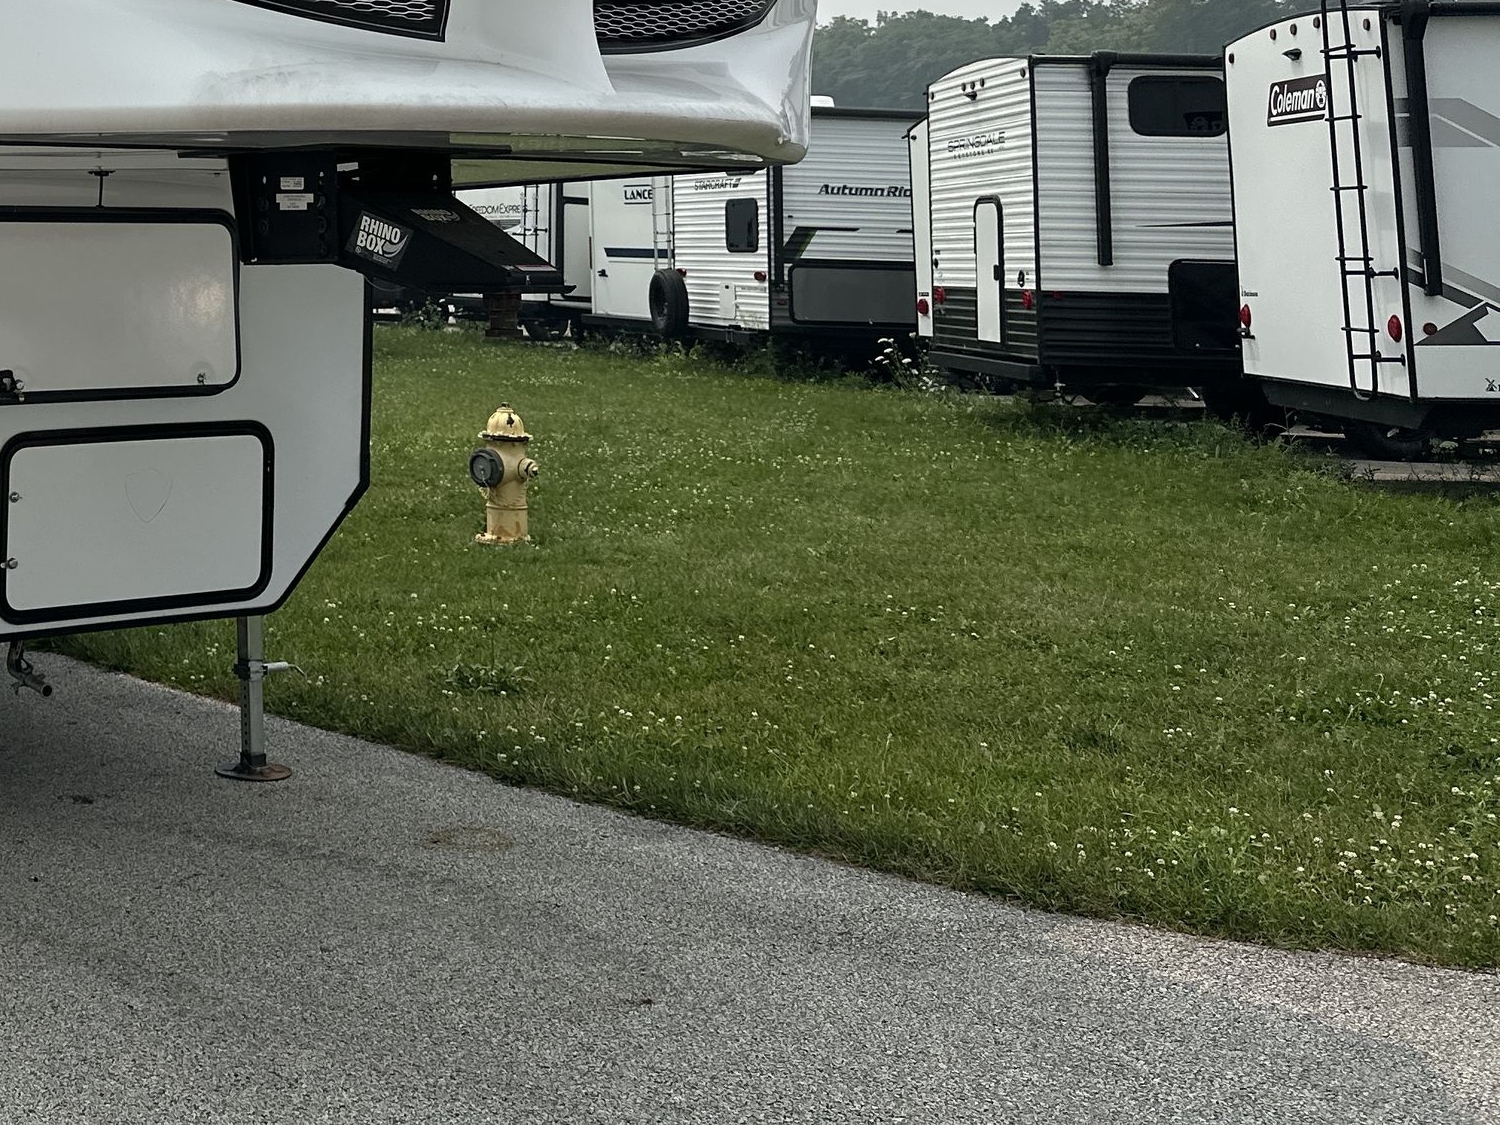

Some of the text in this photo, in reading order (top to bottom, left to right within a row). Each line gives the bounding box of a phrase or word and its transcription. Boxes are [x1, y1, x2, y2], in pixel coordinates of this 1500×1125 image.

[1270, 84, 1315, 116] Coleman
[948, 131, 1006, 152] SPRINGDALE
[624, 189, 652, 200] LANCE
[819, 184, 885, 195] Autumn
[360, 215, 401, 244] RHINO
[356, 230, 386, 255] BOX
